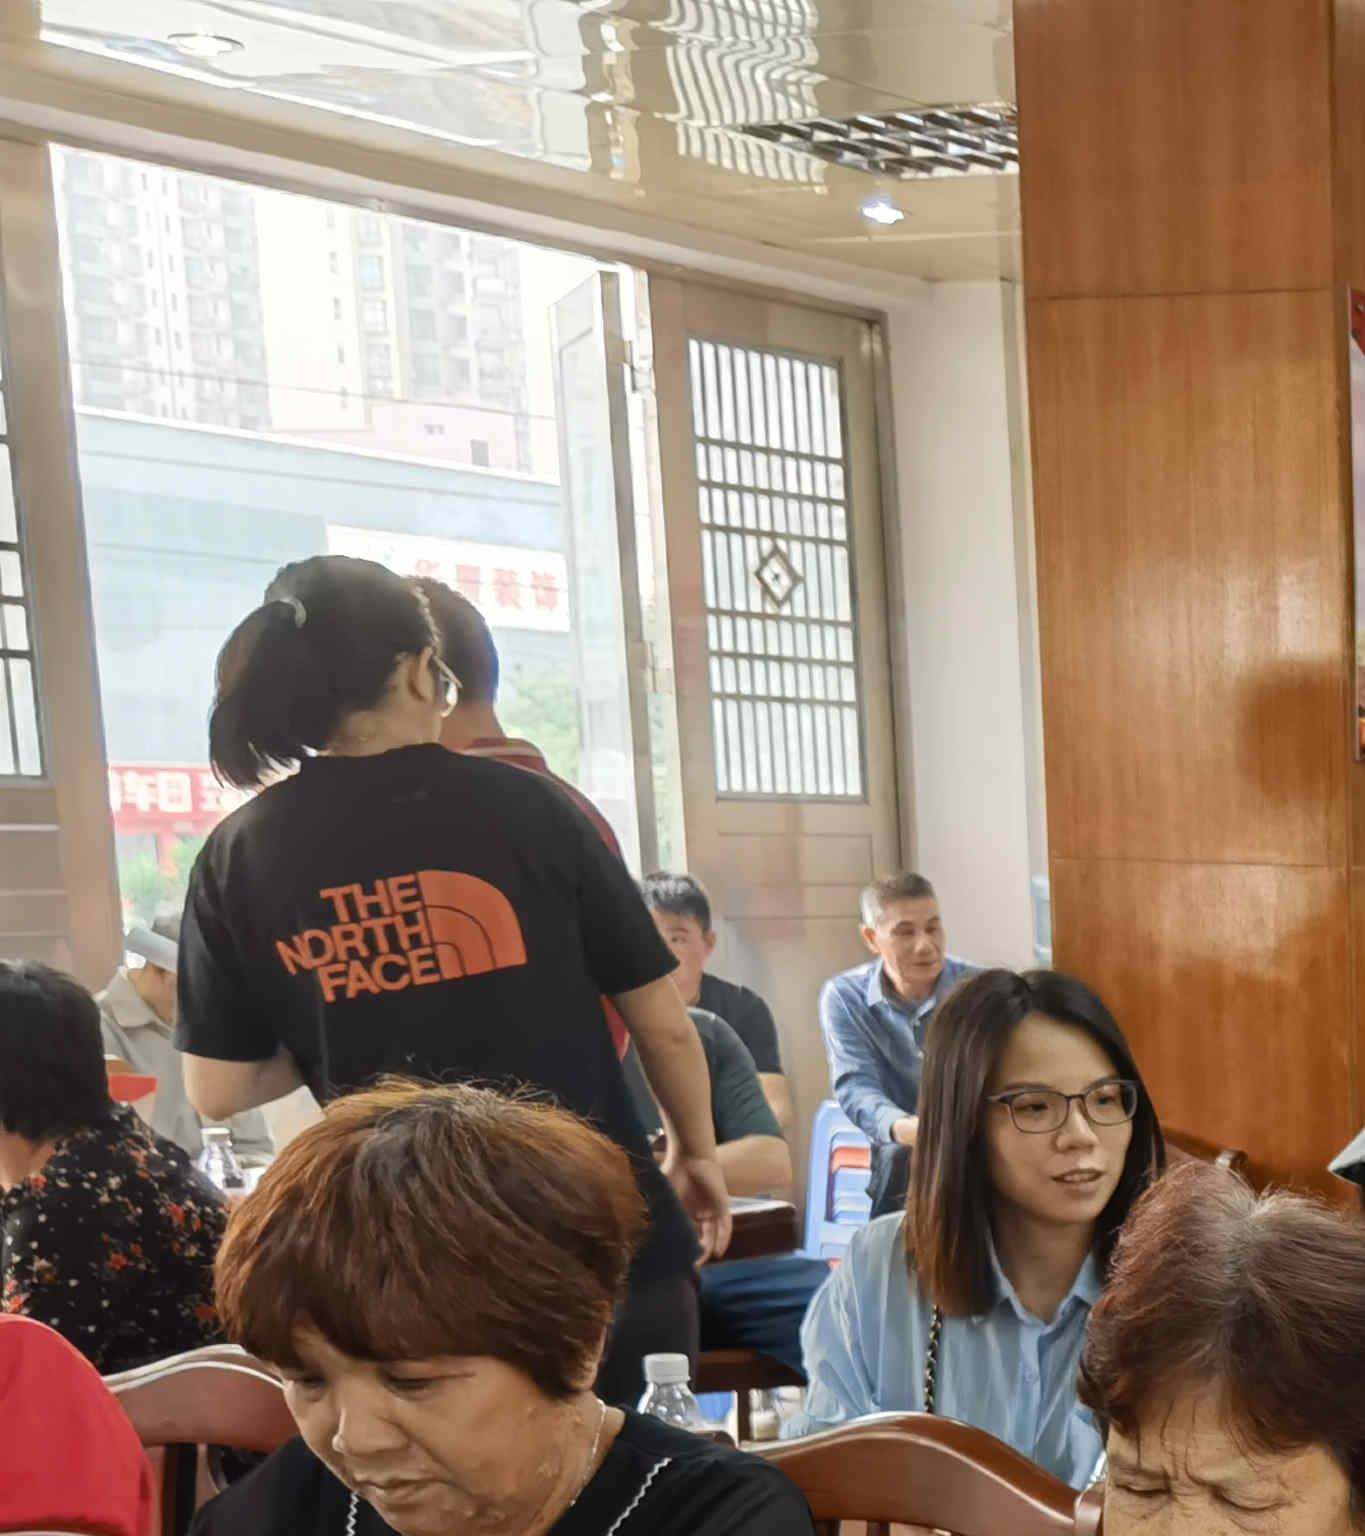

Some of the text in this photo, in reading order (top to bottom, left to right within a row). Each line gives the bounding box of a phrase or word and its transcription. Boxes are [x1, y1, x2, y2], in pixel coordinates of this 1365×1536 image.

[319, 873, 423, 923] THE
[276, 908, 433, 976] NORTH
[317, 946, 440, 1003] FACE
